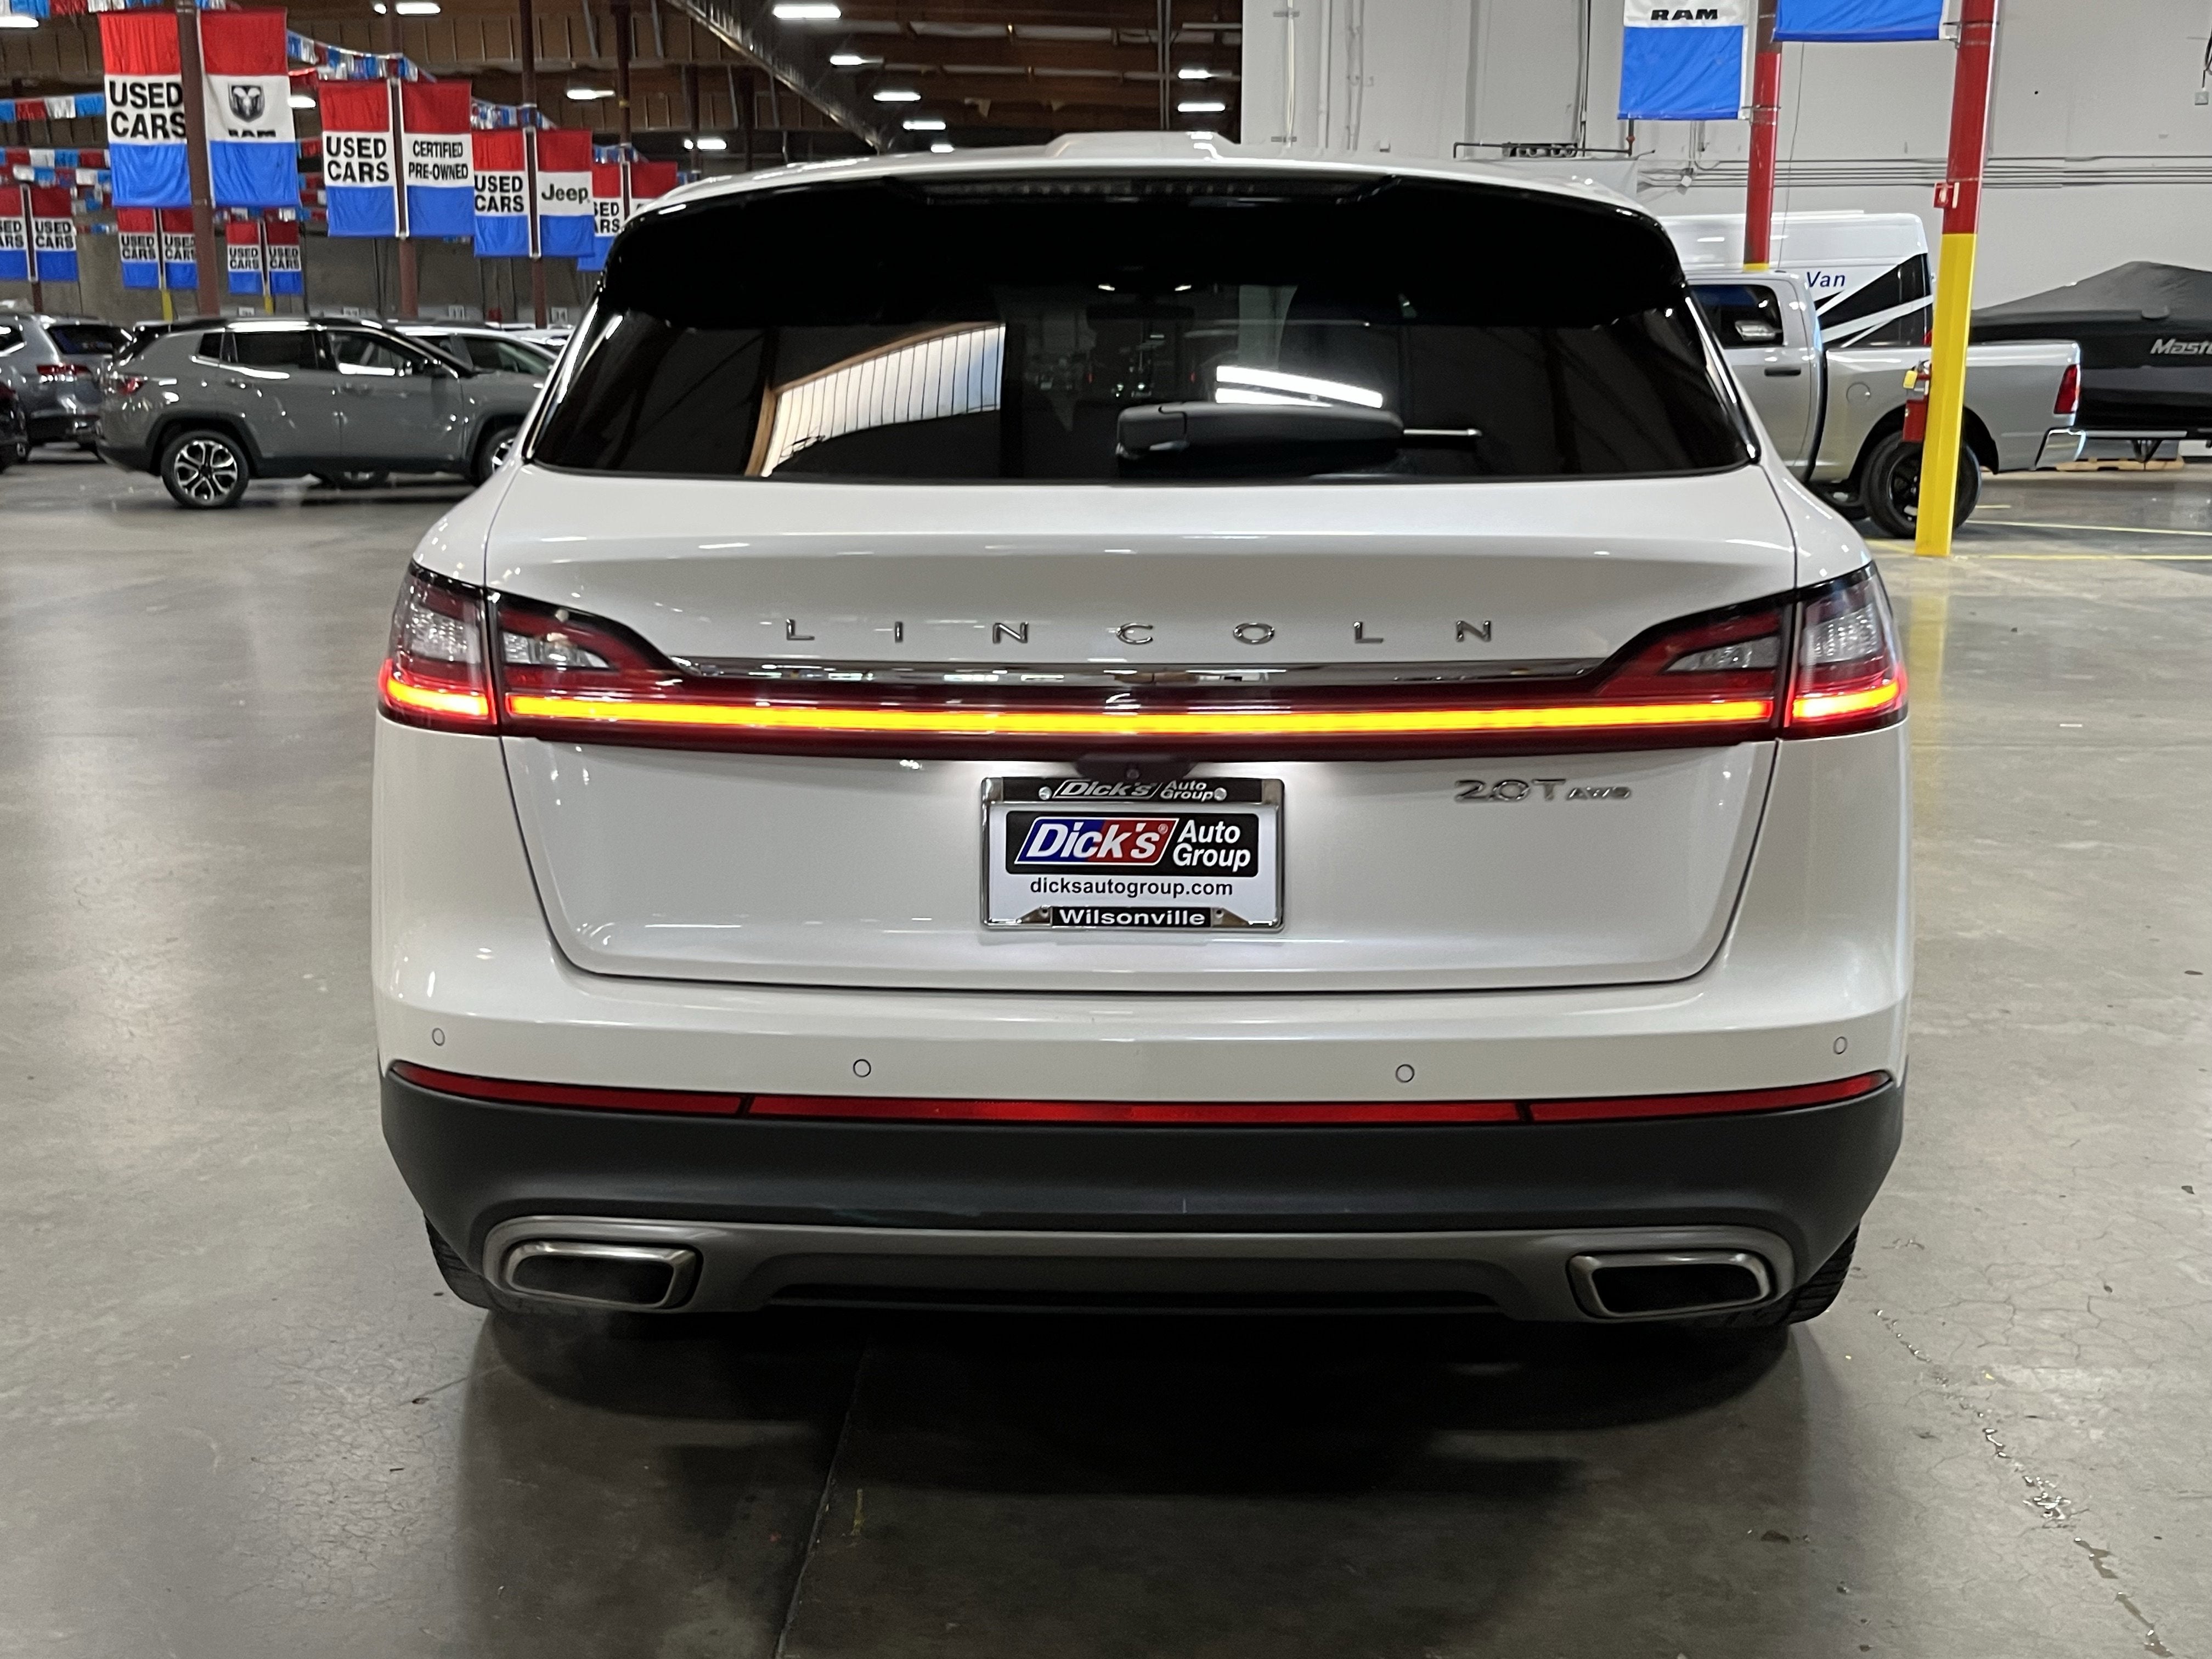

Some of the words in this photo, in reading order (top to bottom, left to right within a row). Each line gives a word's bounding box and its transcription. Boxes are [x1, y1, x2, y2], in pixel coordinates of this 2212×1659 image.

[1651, 9, 1718, 20] RAM
[109, 81, 183, 109] USED
[111, 111, 187, 139] CARS
[326, 136, 387, 159] USED
[413, 140, 464, 159] CERTIFIED
[328, 160, 390, 182] CARS
[409, 162, 469, 180] PRE-OWNED
[474, 175, 523, 193] USED
[541, 183, 588, 204] Jeep
[475, 195, 524, 212] CARS
[35, 220, 71, 233] USED
[36, 235, 74, 249] CARS
[229, 247, 258, 258] USED
[1807, 271, 1845, 287] Van
[786, 618, 1492, 646] LINCOLN
[1060, 781, 1158, 796] Dick's
[1165, 780, 1207, 791] Auto
[1160, 789, 1214, 802] Group
[1177, 820, 1241, 844] Auto
[1172, 843, 1251, 872] Group
[1030, 878, 1233, 899] dicksautogroup.com
[1059, 909, 1206, 926] Wilsonville
